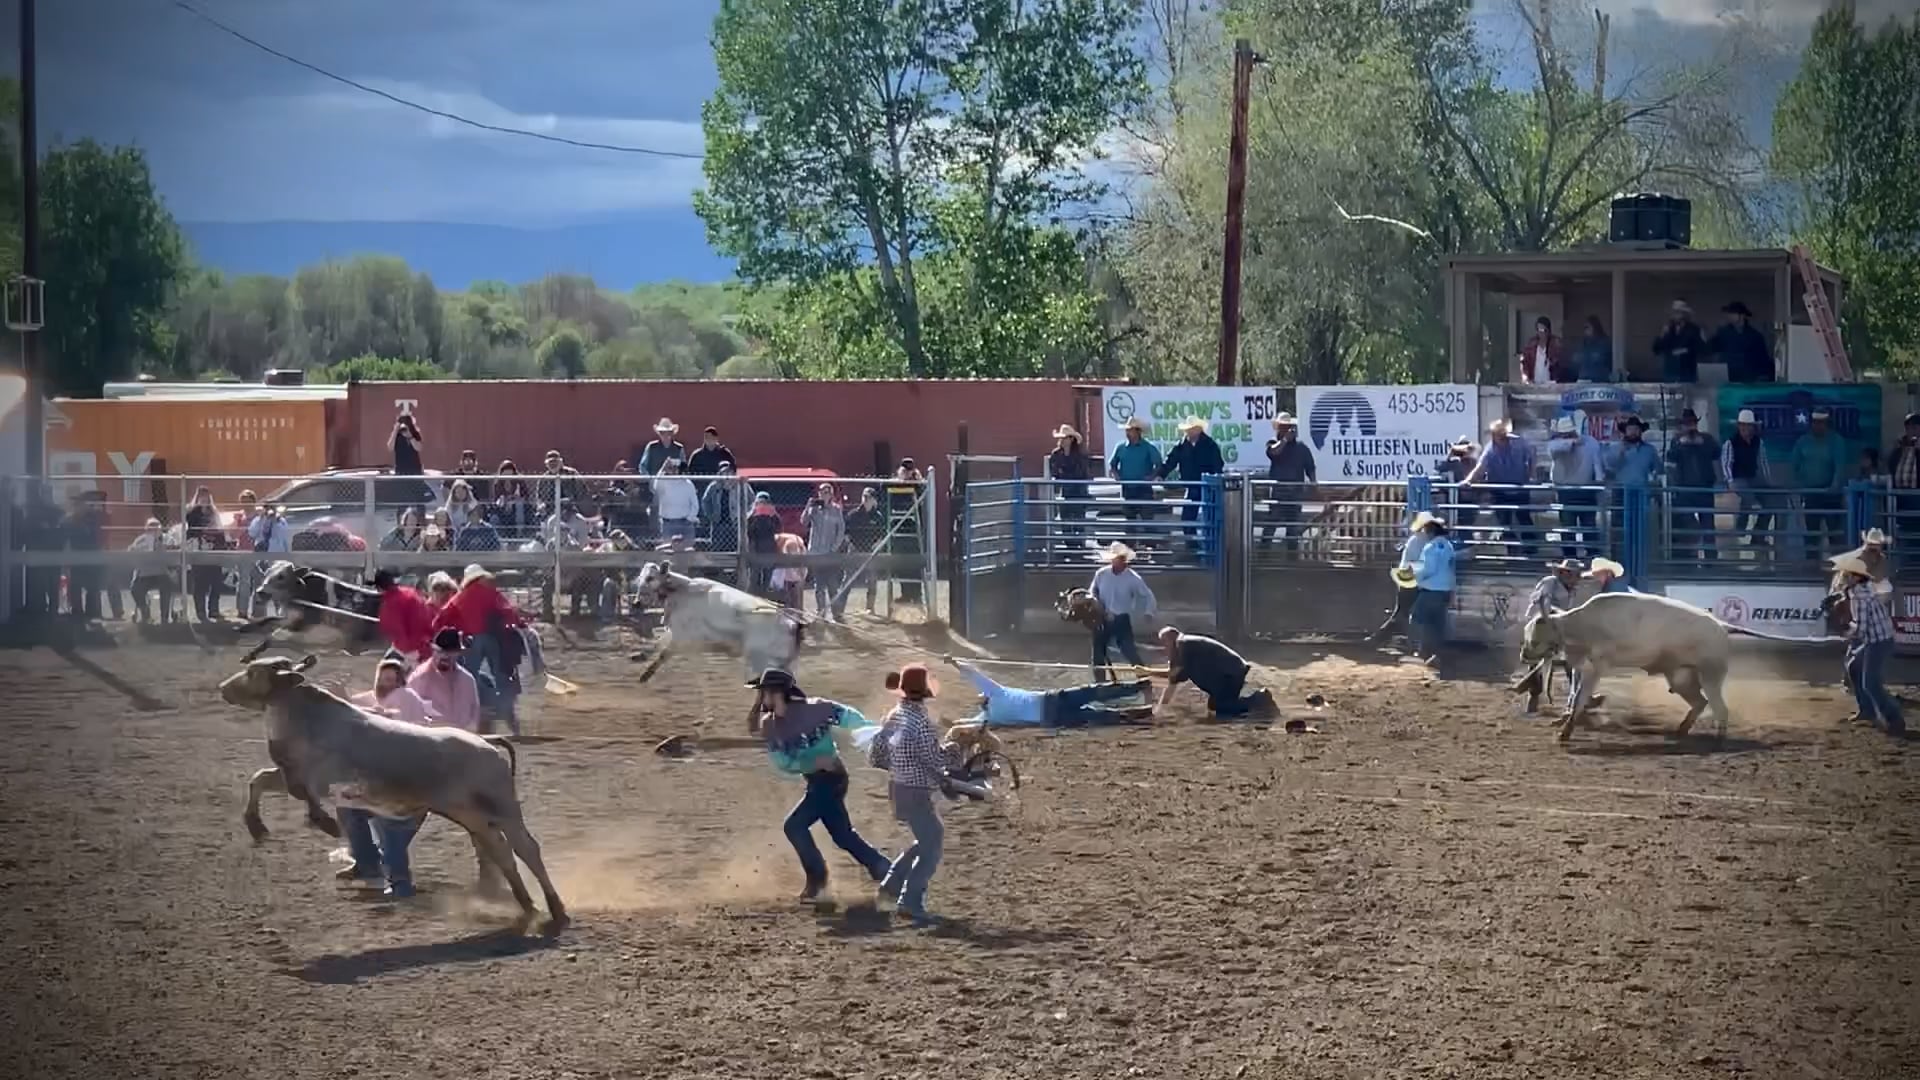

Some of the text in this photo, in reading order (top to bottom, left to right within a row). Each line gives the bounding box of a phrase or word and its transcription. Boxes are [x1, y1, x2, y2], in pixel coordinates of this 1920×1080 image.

[1150, 400, 1231, 420] CROW'S
[1244, 395, 1274, 420] TSC
[1388, 392, 1466, 414] 453-5525
[1332, 439, 1411, 456] HELLIESEN
[1342, 459, 1353, 477] &
[1357, 460, 1403, 480] Supply
[1406, 459, 1428, 477] Co.
